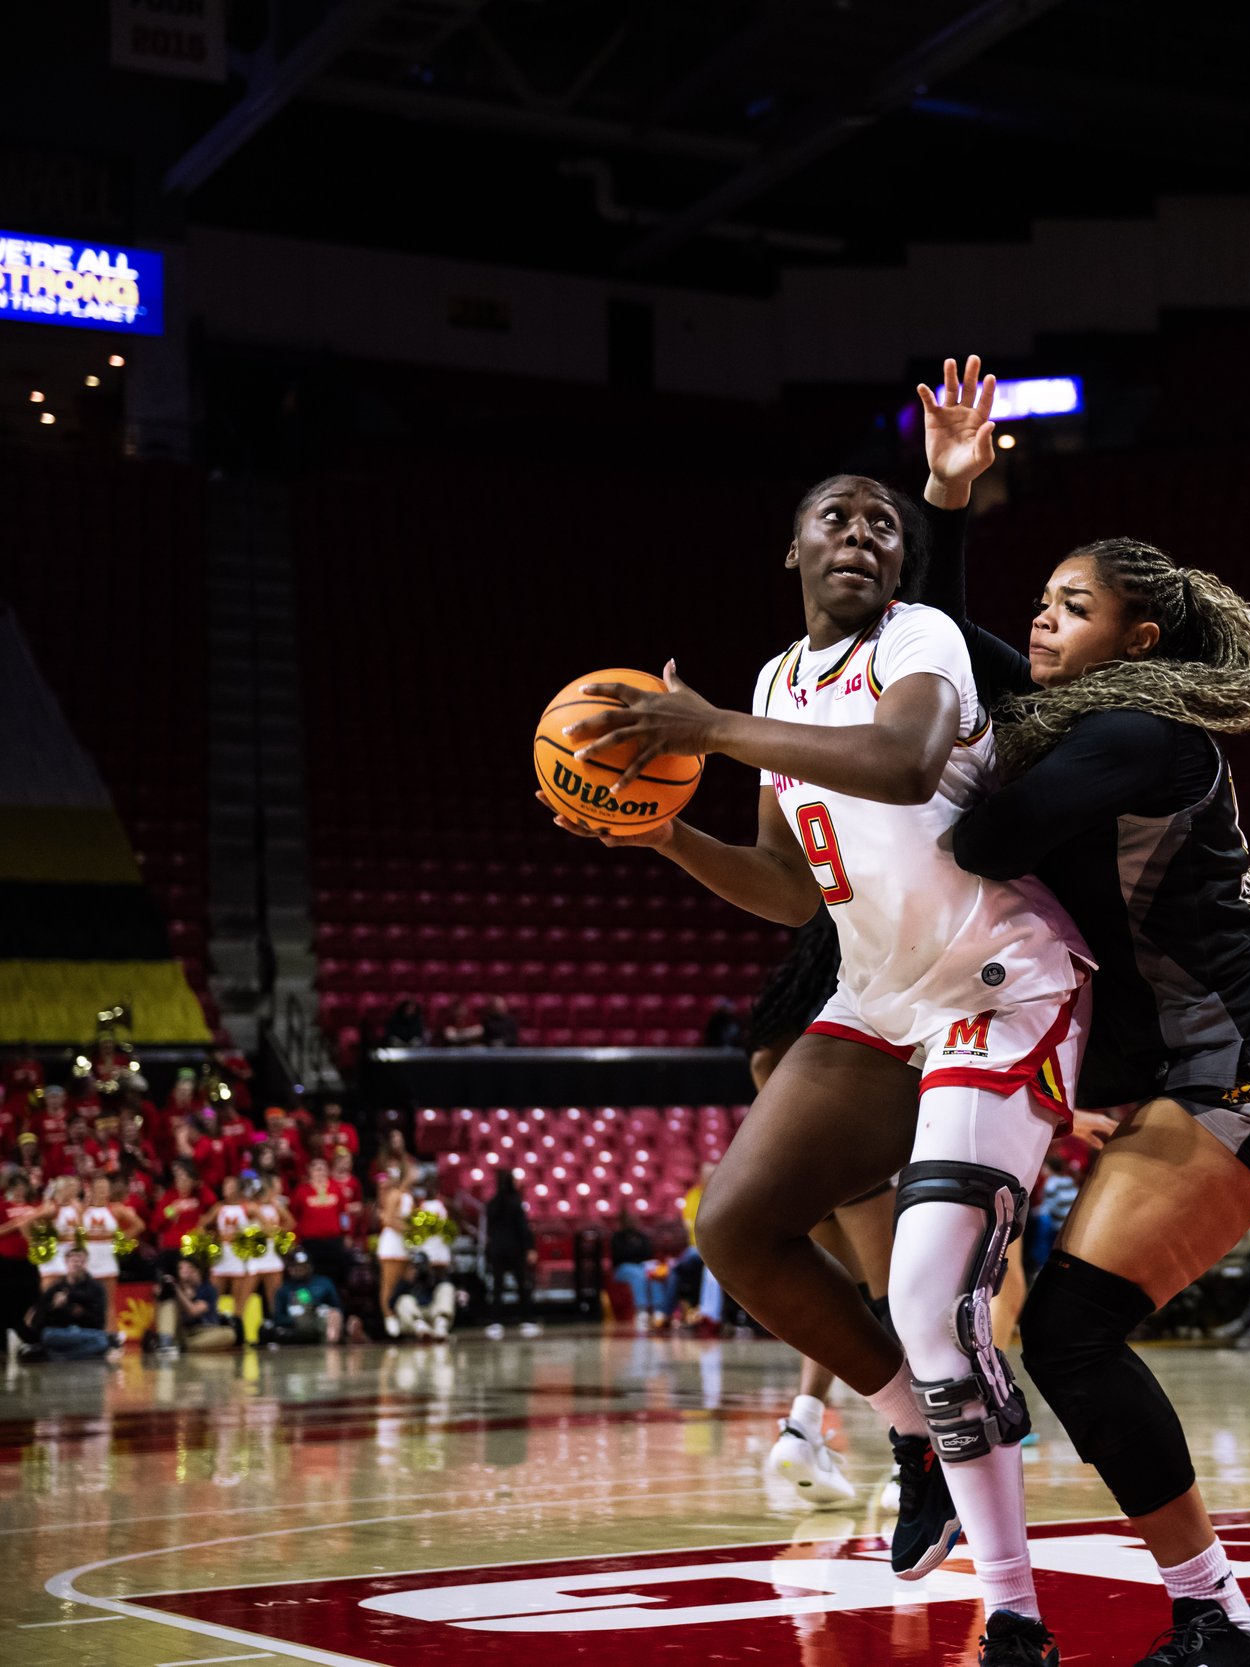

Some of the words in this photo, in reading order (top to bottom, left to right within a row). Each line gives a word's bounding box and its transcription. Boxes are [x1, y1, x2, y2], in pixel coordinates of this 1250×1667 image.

[0, 237, 74, 271] E'RE
[77, 248, 139, 281] ALL
[0, 265, 139, 306] TRONG
[553, 760, 659, 816] Wilson
[796, 801, 854, 906] 9
[944, 1009, 997, 1051] M
